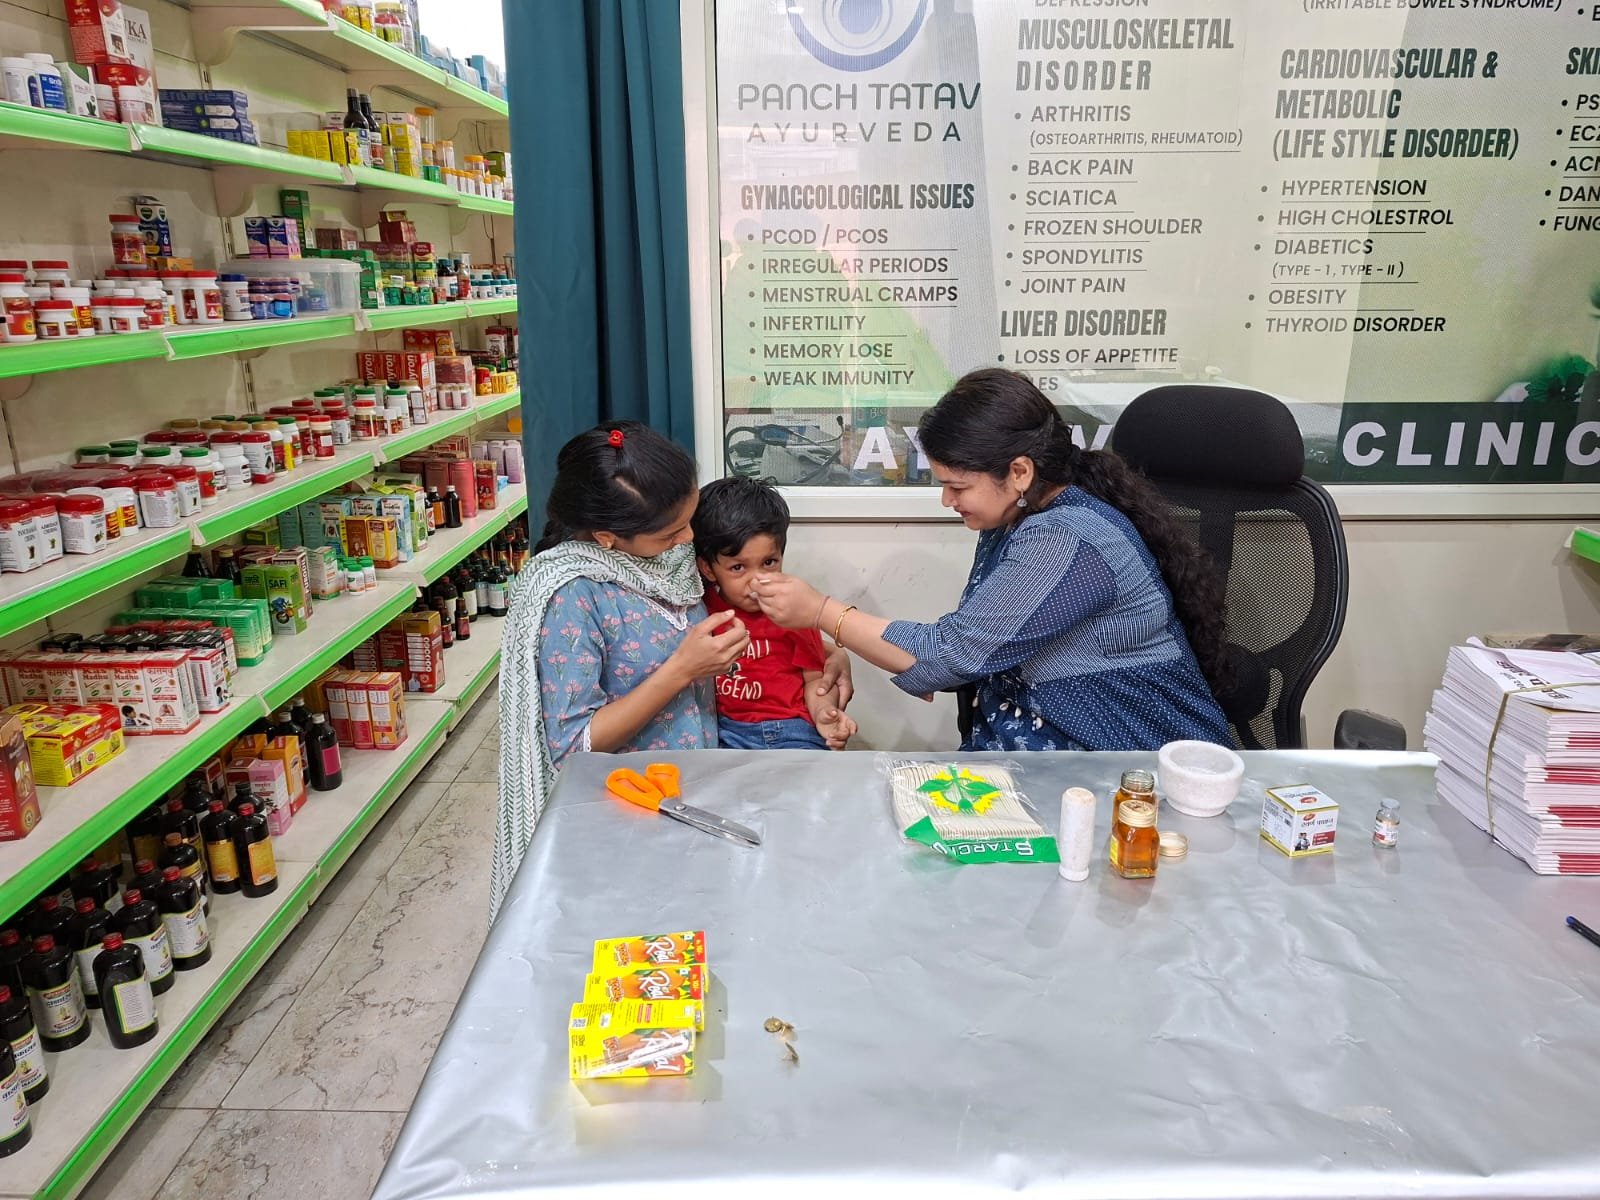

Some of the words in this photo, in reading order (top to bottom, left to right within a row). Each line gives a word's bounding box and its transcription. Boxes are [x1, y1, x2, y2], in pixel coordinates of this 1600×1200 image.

[1460, 0, 1562, 12] SYNDROME)
[1018, 18, 1235, 50] MUSCULOSKELETAL
[1280, 48, 1477, 79] CARDIOVASCULAR
[1482, 50, 1498, 79] &
[1016, 60, 1151, 91] DISORDER
[738, 83, 857, 111] PANCH
[869, 82, 981, 110] TATAV
[1275, 89, 1402, 119] METABOLIC
[1030, 105, 1131, 122] ARTHRITIS
[747, 121, 962, 143] AYURVEDA
[1029, 131, 1148, 149] (OSTEOARTHRITIS,
[1151, 130, 1243, 147] RHEUMATOID)
[1272, 128, 1326, 161] (LIFE
[1331, 128, 1396, 159] STYLE
[1402, 128, 1520, 161] DISORDER)
[1028, 160, 1082, 176] BACK
[1087, 159, 1133, 176] PAIN
[1281, 180, 1427, 197] HYPERTENSION
[741, 185, 904, 211] GYNACCOLOGICAL
[909, 184, 975, 210] ISSUES
[1026, 190, 1118, 206] SCIATICA
[1278, 210, 1327, 227] HIGH
[1331, 209, 1454, 226] CHOLESTROL
[762, 229, 816, 245] PCOD
[836, 228, 888, 245] PCOS
[1024, 220, 1097, 237] FROZEN
[1102, 219, 1203, 236] SHOULDER
[1274, 239, 1374, 256] DIABETICS
[762, 258, 863, 275] IRREGULAR
[869, 257, 948, 274] PERIODS
[1022, 249, 1143, 266] SPONDYLITIS
[1272, 262, 1311, 279] (TYPE
[1340, 264, 1373, 277] TYPE
[763, 287, 873, 303] MENSTRUAL
[878, 286, 958, 302] CRAMPS
[1020, 278, 1076, 295] JOINT
[1082, 277, 1126, 294] PAIN
[1268, 290, 1347, 305] OBESITY
[763, 315, 866, 331] INFERTILITY
[1000, 310, 1057, 338] LIVER
[1065, 309, 1168, 337] DISORDER
[1266, 317, 1348, 333] THYROID
[1353, 316, 1446, 333] DISORDER
[763, 344, 844, 360] MEMORY
[849, 343, 893, 359] LOSE
[1014, 349, 1060, 364] LOSS
[1066, 349, 1089, 364] OF
[1095, 348, 1178, 364] APPETITE
[764, 371, 817, 387] WEAK
[822, 370, 914, 386] IMMUNITY
[1342, 421, 1600, 467] CLINIC
[268, 579, 288, 588] SAFI
[645, 936, 680, 963] Real
[638, 970, 675, 1000] Real
